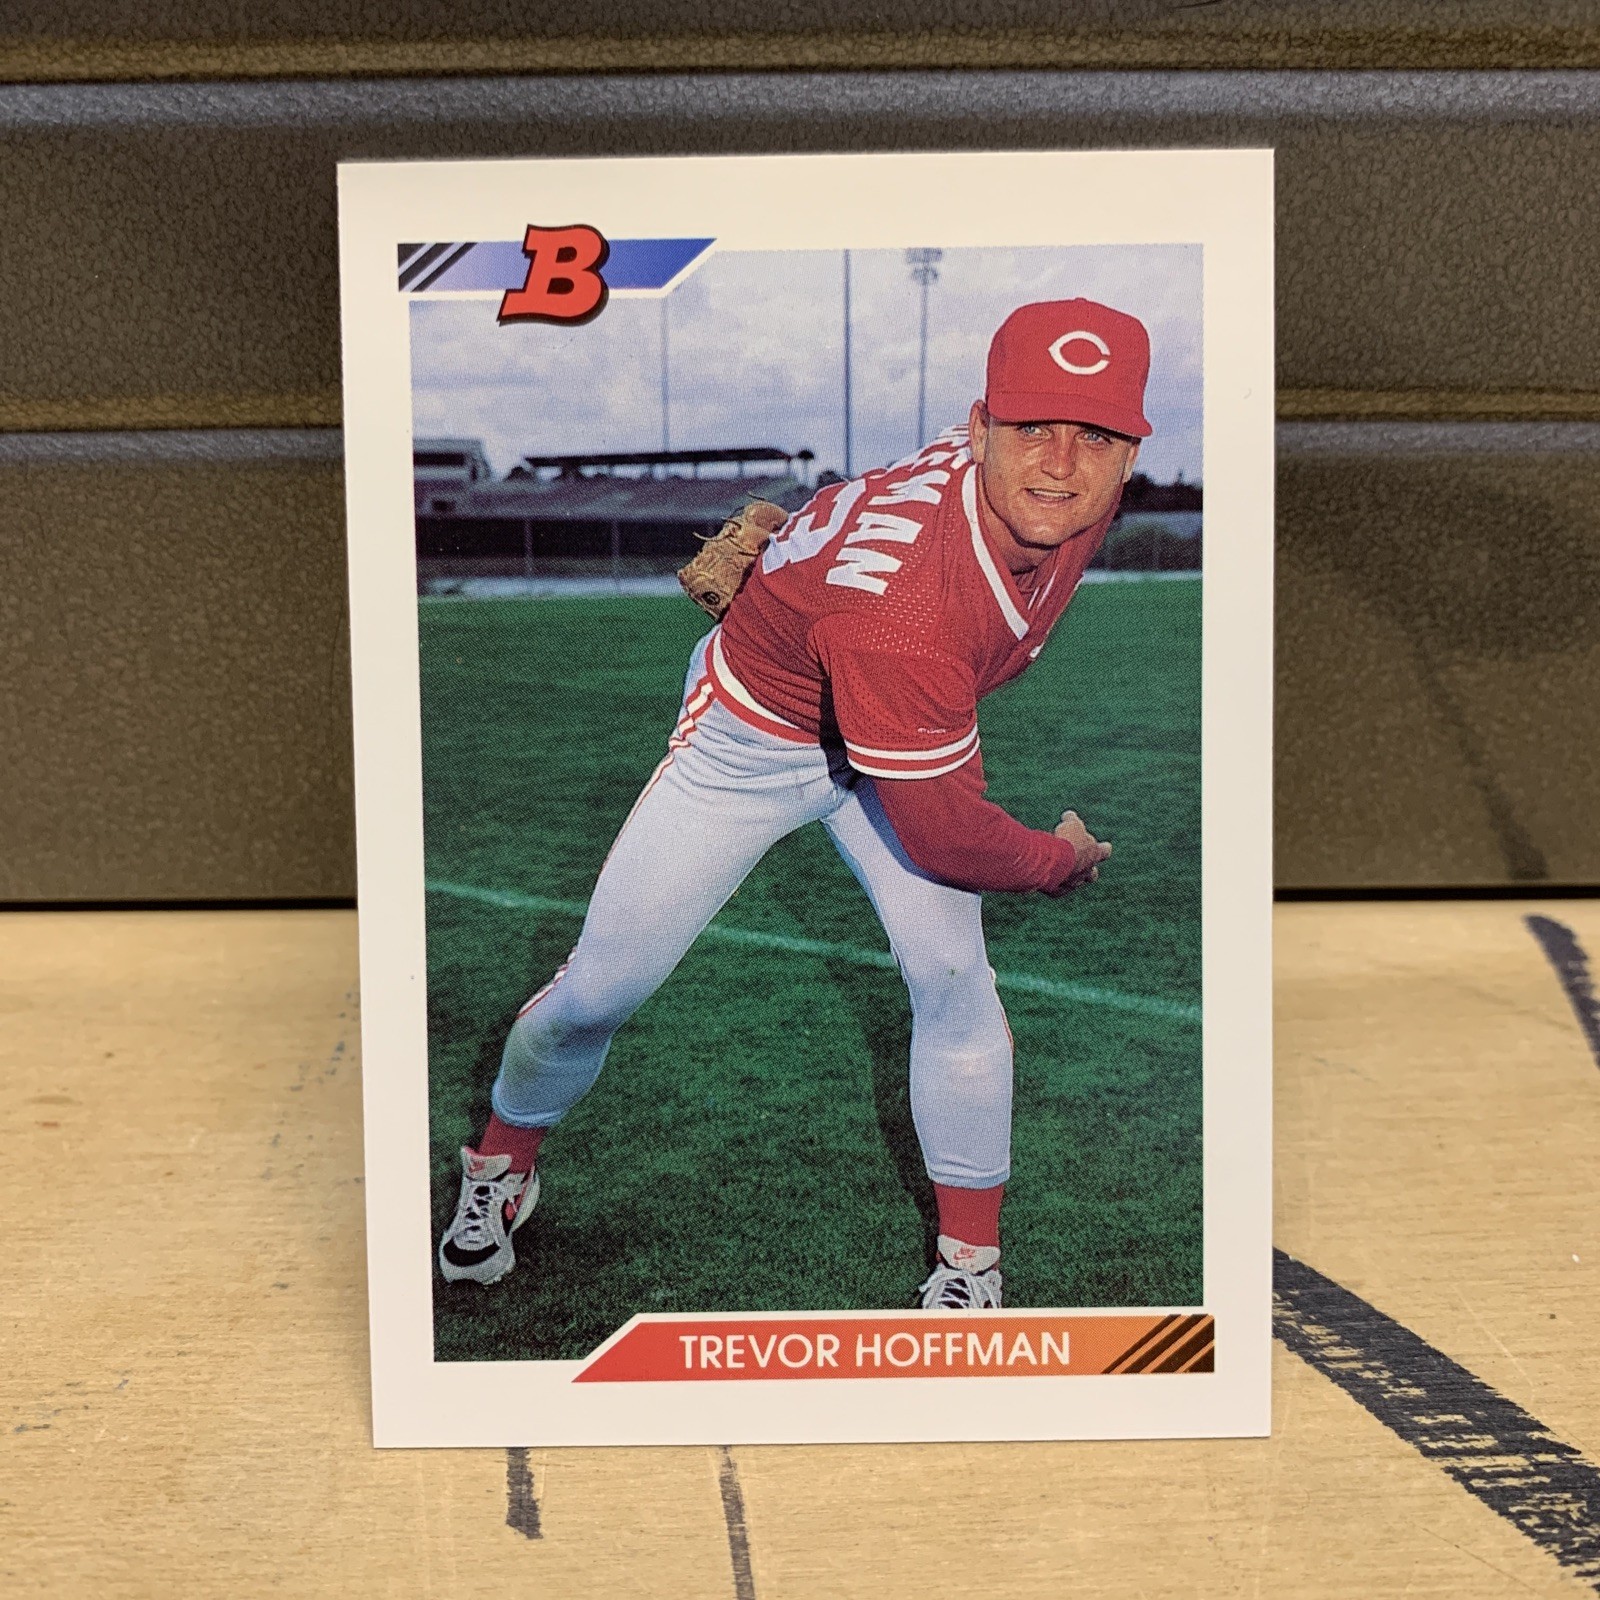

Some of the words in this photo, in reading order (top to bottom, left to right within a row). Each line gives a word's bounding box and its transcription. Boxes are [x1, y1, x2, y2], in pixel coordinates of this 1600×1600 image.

[497, 224, 610, 327] B
[1048, 330, 1111, 375] C
[679, 1333, 841, 1369] TREVOR
[855, 1331, 1070, 1367] HOFFMAN
